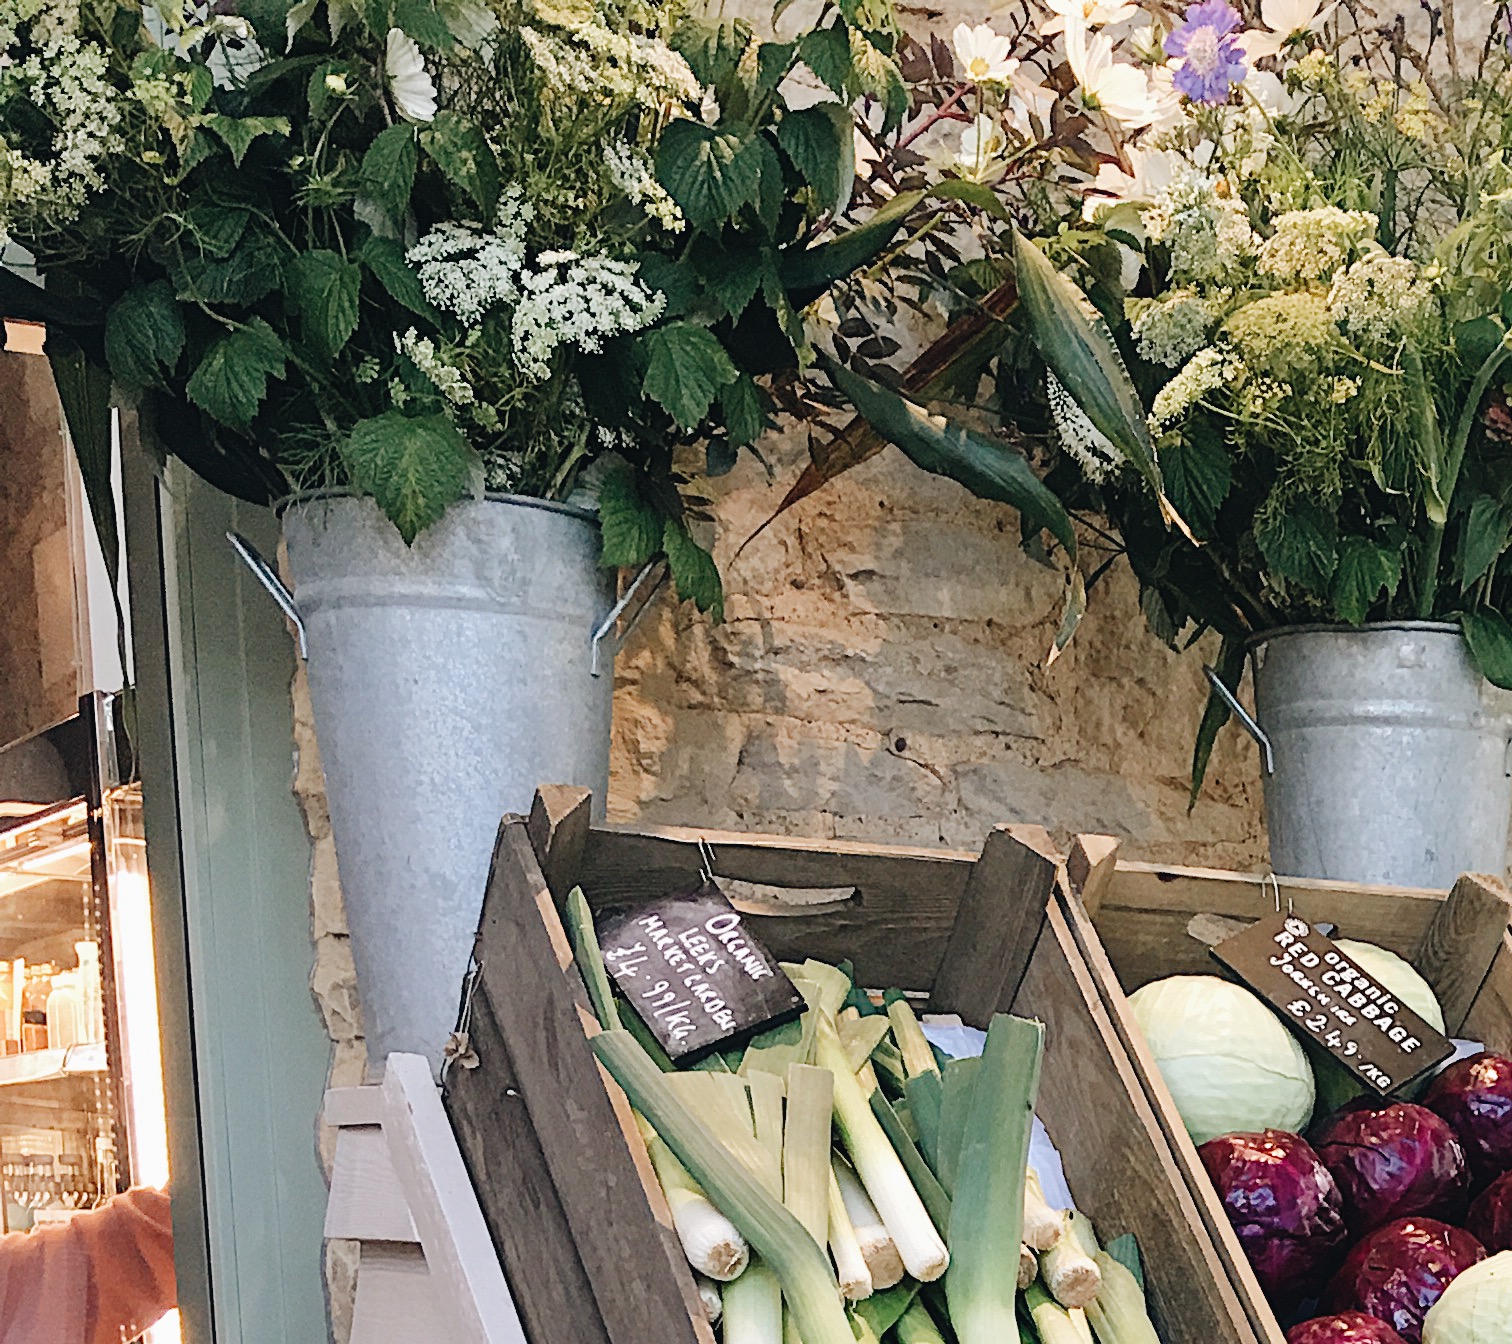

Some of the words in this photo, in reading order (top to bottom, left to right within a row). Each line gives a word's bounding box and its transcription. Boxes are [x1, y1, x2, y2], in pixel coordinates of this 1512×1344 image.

[639, 915, 695, 973] MARKET
[684, 975, 736, 1031] GARDEN
[678, 928, 725, 974] LEEKS
[705, 913, 773, 980] ORGANIC
[1274, 932, 1320, 967] RED
[1322, 971, 1420, 1053] CABBAGE
[1324, 952, 1398, 1015] organic
